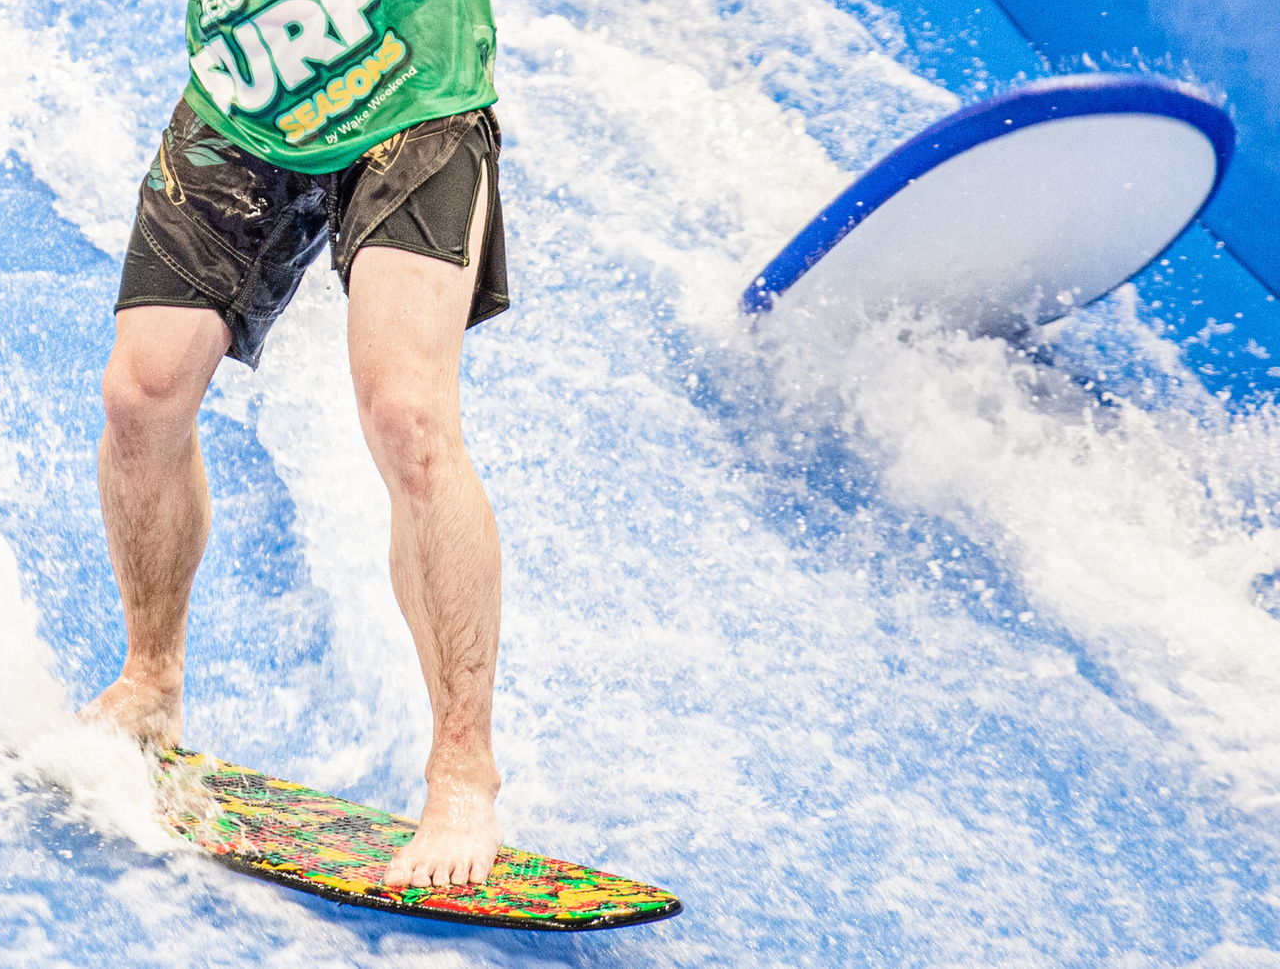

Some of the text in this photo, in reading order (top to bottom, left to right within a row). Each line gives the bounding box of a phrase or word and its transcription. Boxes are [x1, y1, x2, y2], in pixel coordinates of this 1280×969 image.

[277, 33, 404, 141] SEASONS
[325, 66, 418, 144] by Wake Weekend
